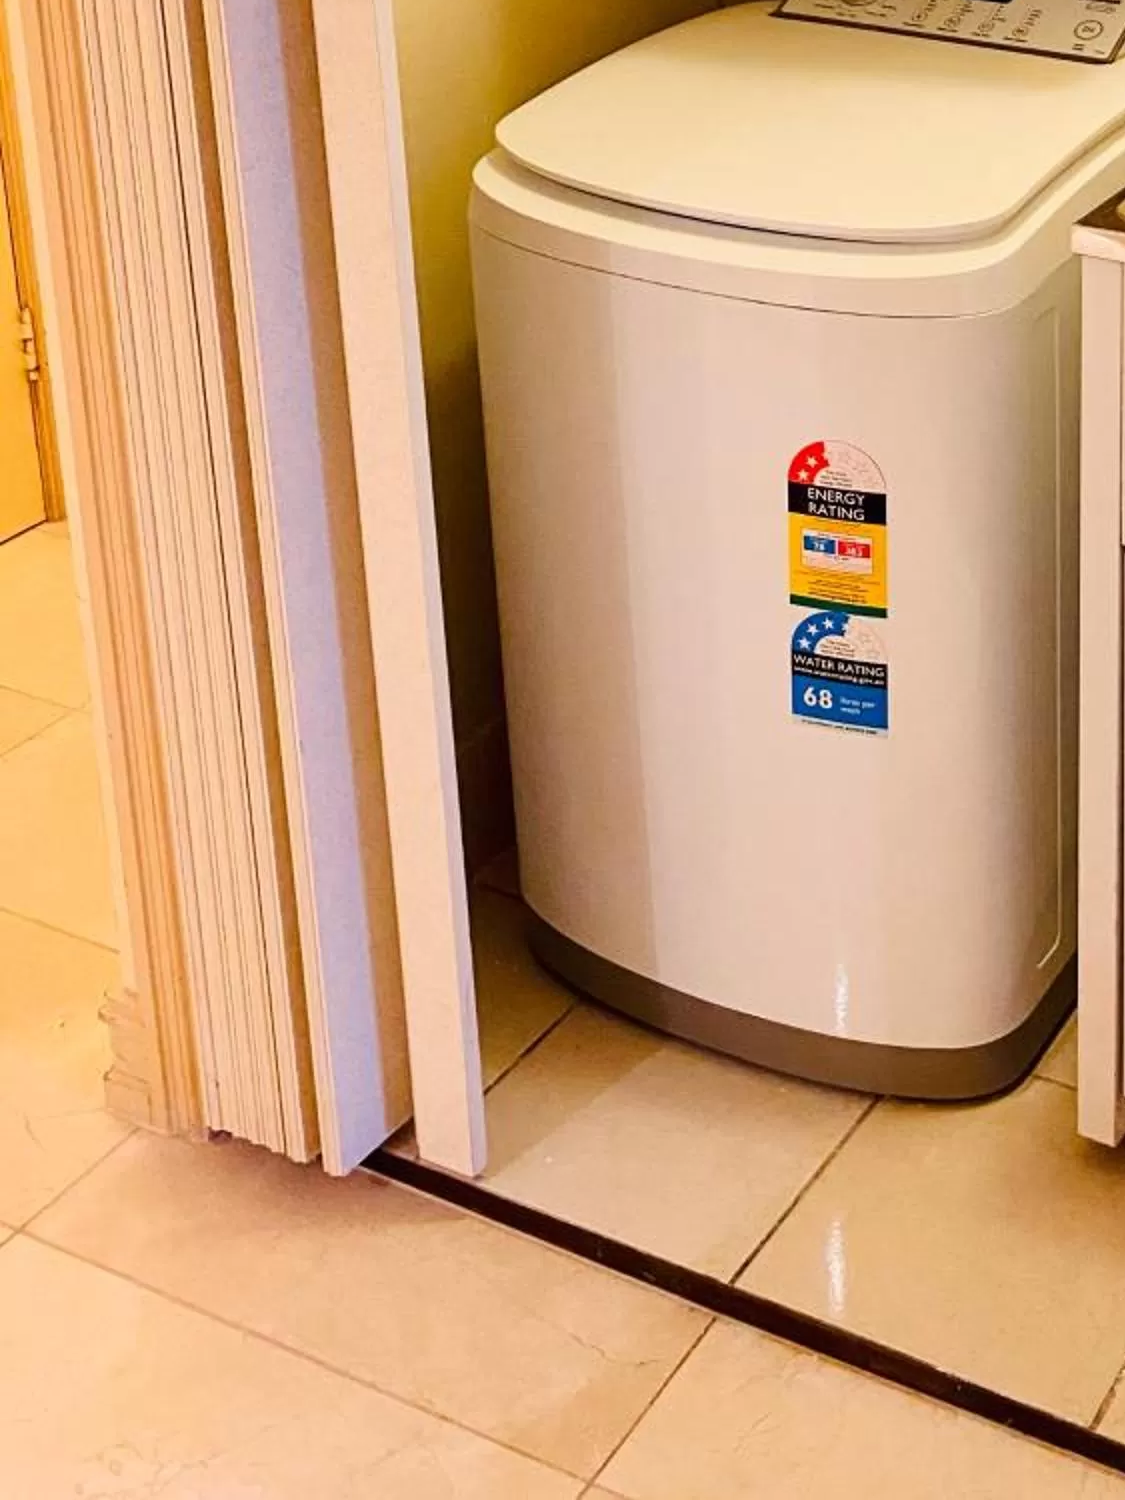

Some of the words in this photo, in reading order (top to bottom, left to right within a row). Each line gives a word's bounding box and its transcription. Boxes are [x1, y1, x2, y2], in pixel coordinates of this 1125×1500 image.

[807, 487, 865, 506] ENERGY
[807, 501, 865, 521] RATING
[793, 654, 835, 671] WATER
[837, 661, 885, 677] RATING
[803, 686, 833, 709] 68
